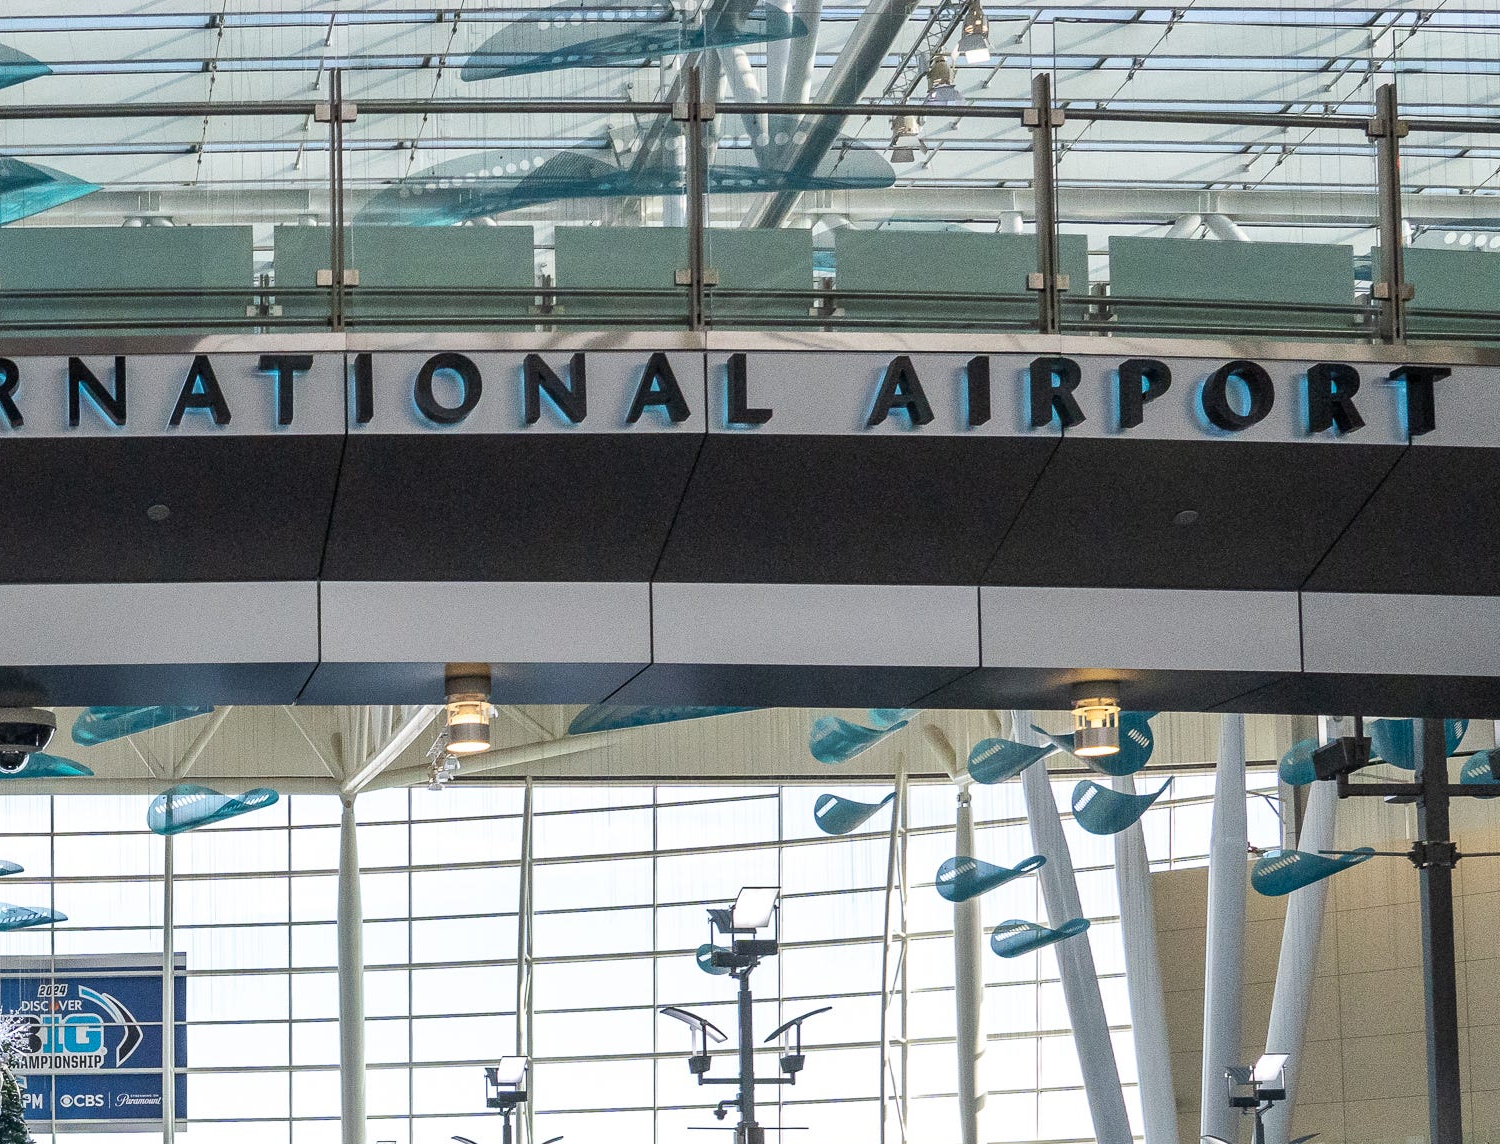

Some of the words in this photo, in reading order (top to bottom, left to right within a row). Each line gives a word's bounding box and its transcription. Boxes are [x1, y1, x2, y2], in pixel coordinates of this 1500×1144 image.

[867, 355, 1452, 436] AIRPORT
[38, 984, 67, 996] 2024
[21, 1000, 83, 1012] DISCOVER
[73, 1094, 104, 1107] CBS
